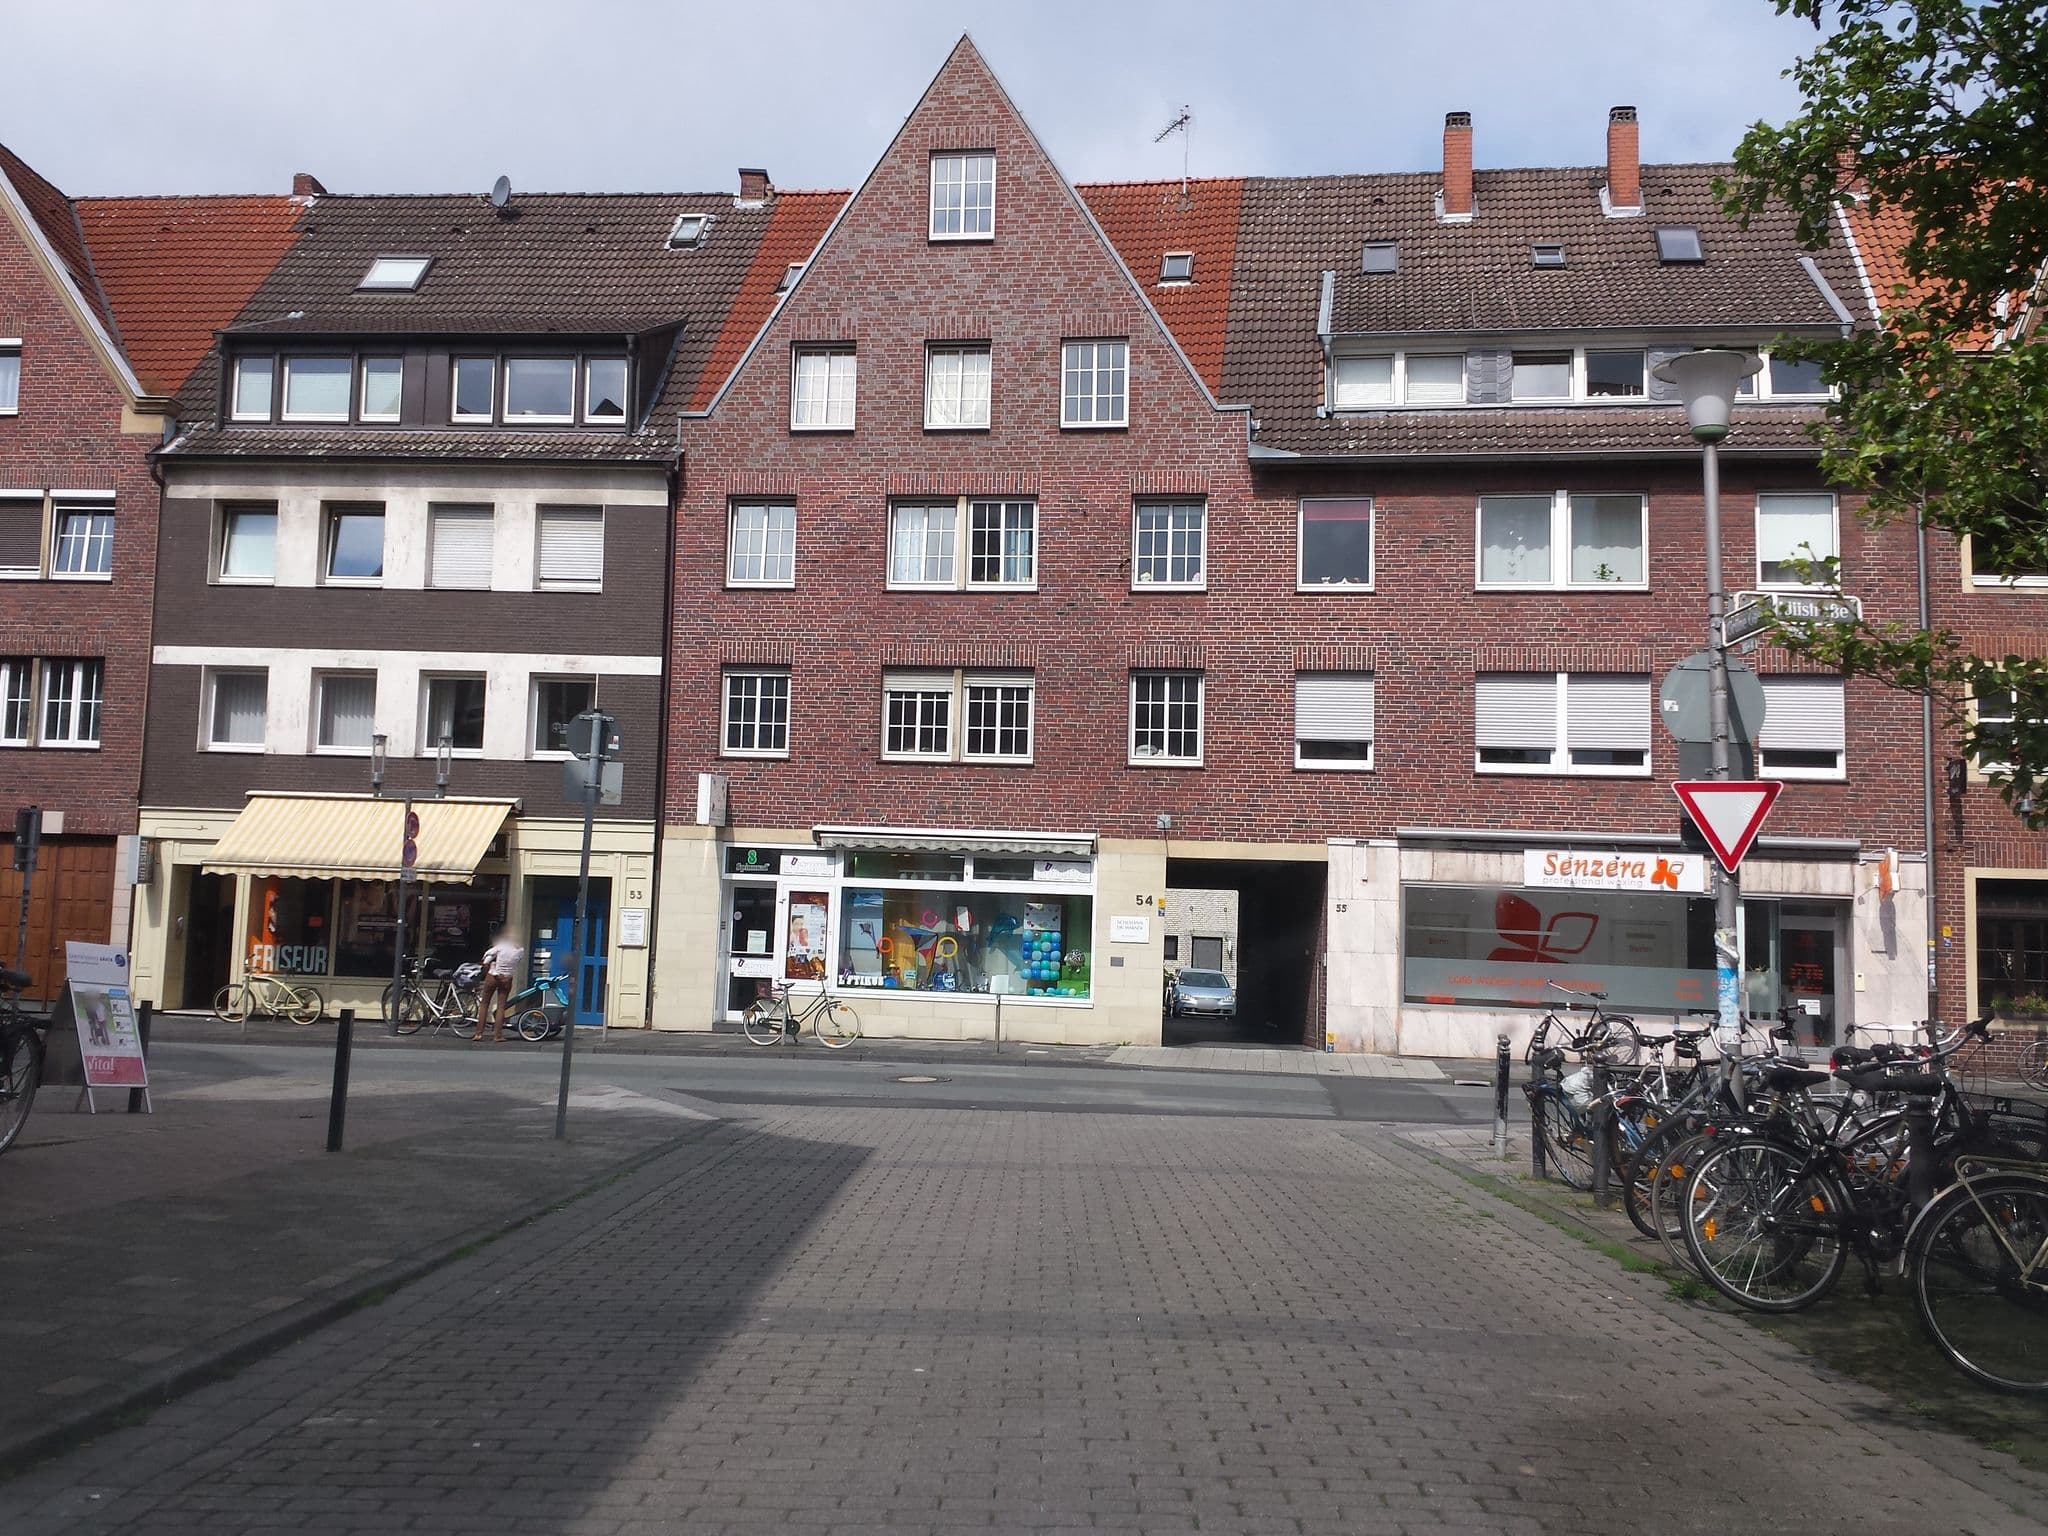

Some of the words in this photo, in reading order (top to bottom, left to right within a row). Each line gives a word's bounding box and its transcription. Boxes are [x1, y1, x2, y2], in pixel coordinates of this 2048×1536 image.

[138, 839, 149, 882] FRISEUR
[1542, 876, 1604, 887] profesional
[629, 890, 643, 900] 53
[1136, 894, 1153, 906] 54
[1335, 904, 1347, 913] 55
[252, 943, 329, 974] FRISEUR
